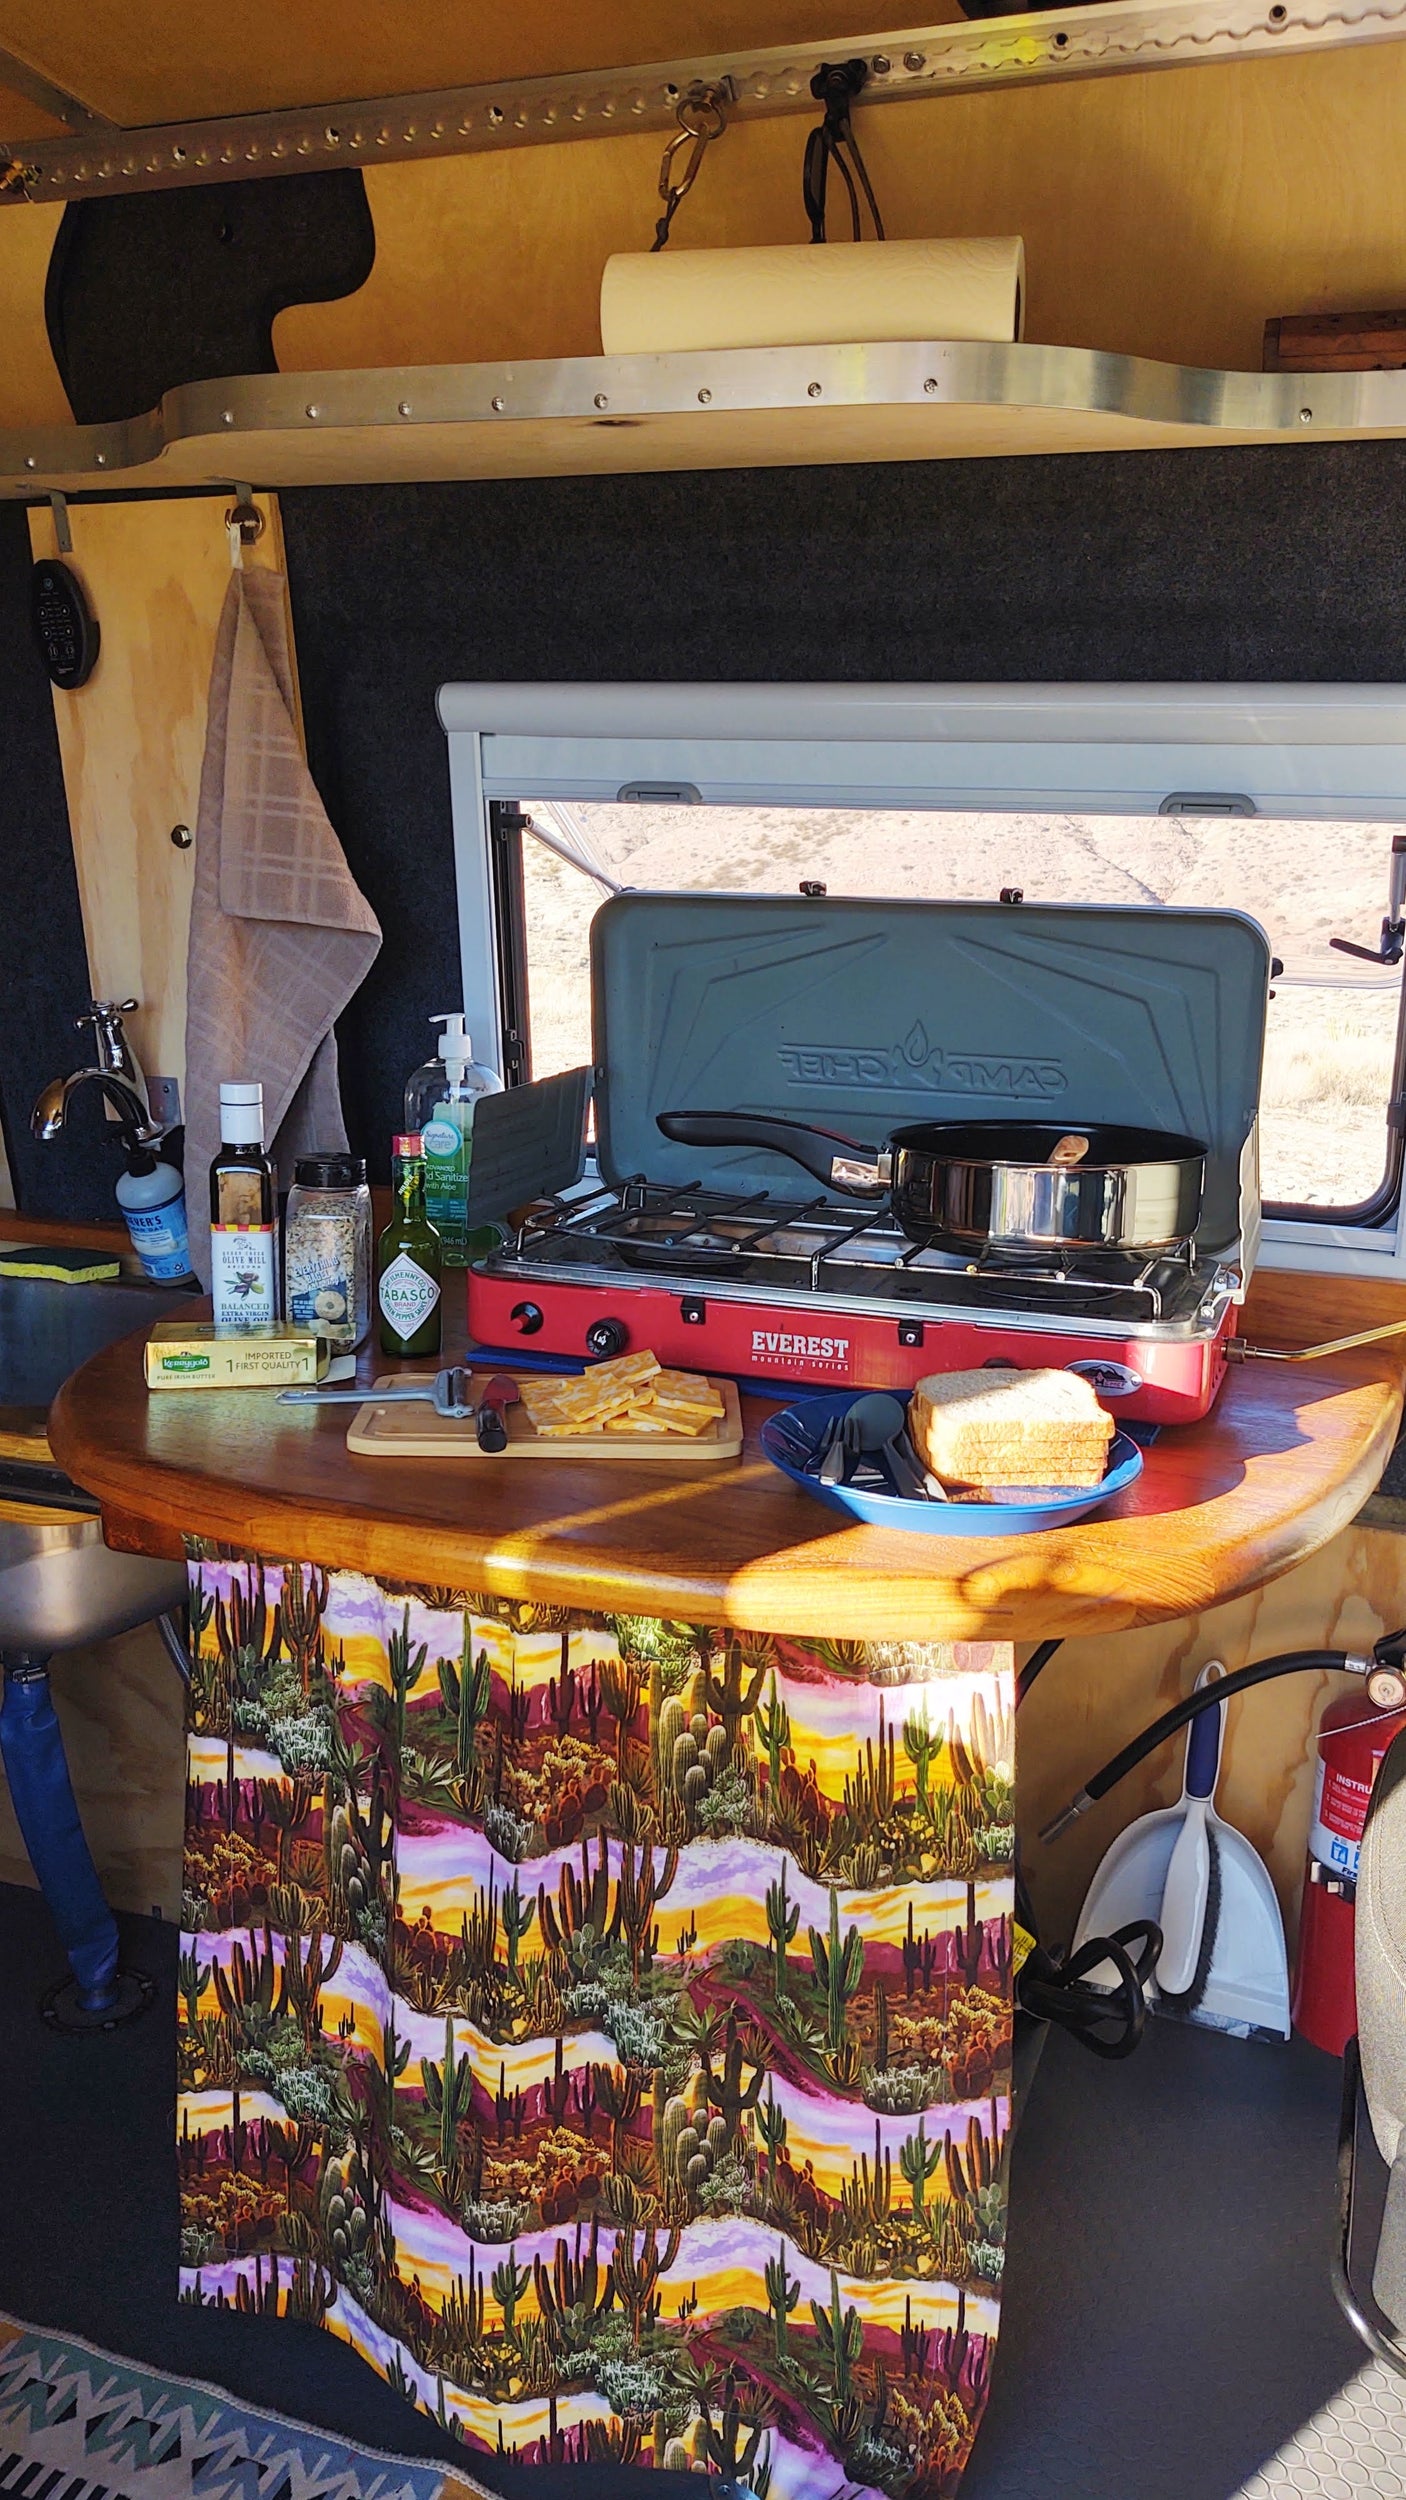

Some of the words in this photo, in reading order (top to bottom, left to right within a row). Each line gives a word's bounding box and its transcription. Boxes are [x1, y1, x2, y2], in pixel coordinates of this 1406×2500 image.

[429, 1140, 452, 1150] care
[436, 1172, 469, 1183] Sanitize
[441, 1183, 457, 1191] Aloe
[380, 1286, 435, 1301] TABASCO
[752, 1331, 849, 1359] EVEREST
[245, 1351, 292, 1361] IMPORTED
[226, 1359, 234, 1373] 1
[235, 1361, 260, 1370] FIRST
[261, 1360, 300, 1370] QUALITY
[302, 1357, 309, 1371] 1
[751, 1355, 804, 1367] mountain
[811, 1360, 849, 1372] series
[1336, 1773, 1373, 1795] INSTRU
[1341, 1866, 1358, 1878] Firs
